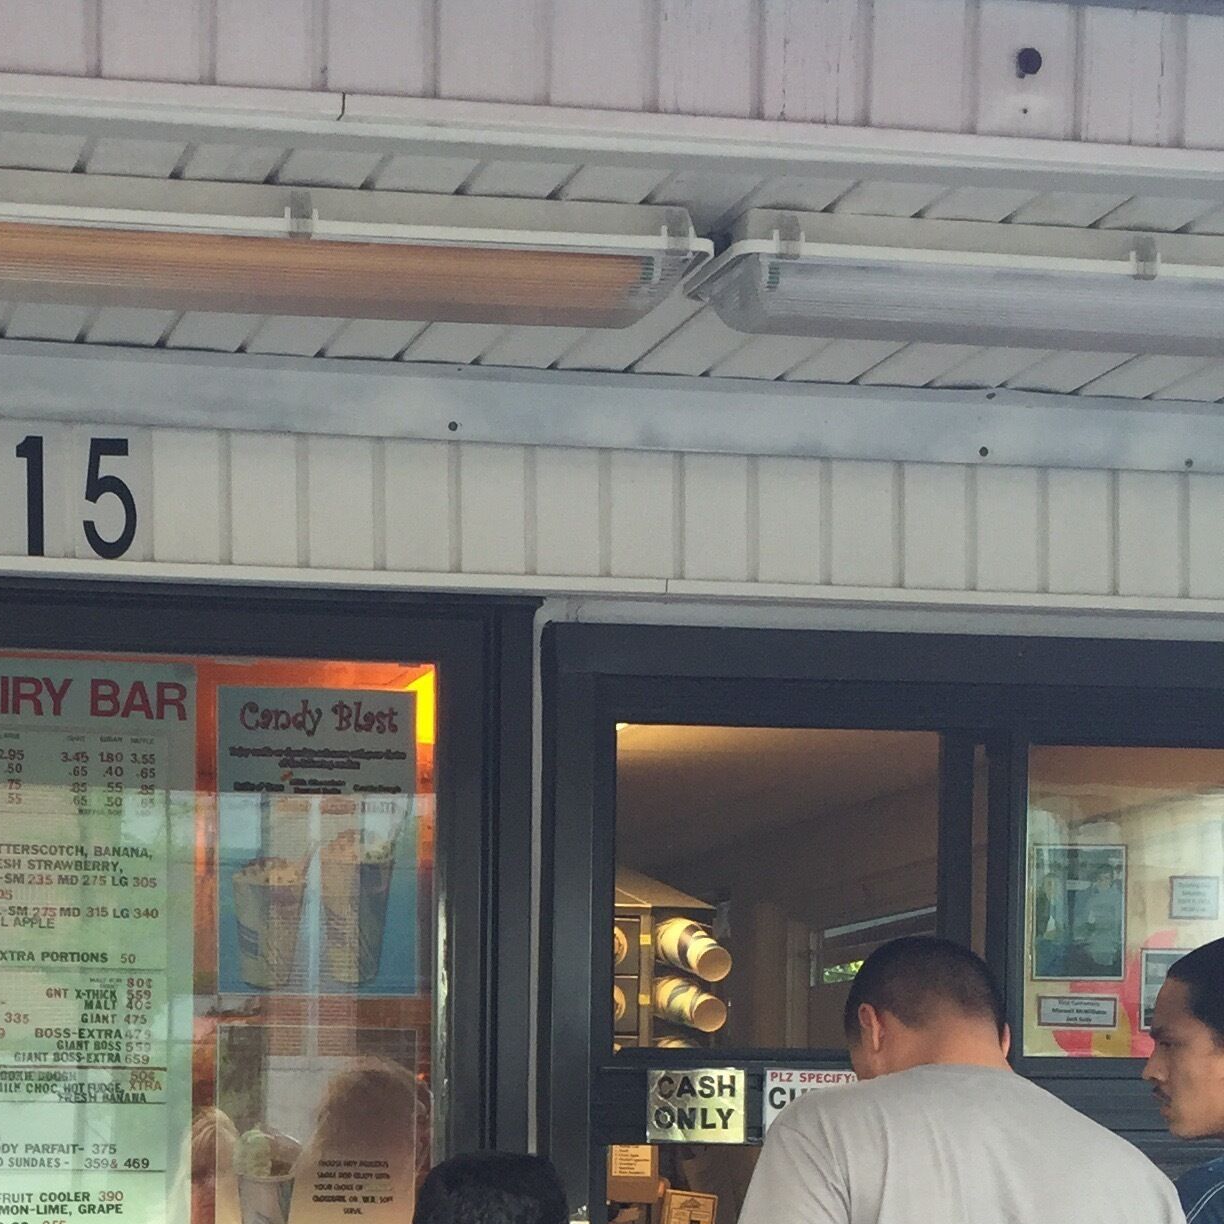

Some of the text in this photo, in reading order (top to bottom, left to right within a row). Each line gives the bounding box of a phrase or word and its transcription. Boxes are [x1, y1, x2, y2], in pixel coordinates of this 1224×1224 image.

[89, 678, 188, 721] BAR
[240, 700, 398, 736] Candy Blast
[658, 1075, 735, 1099] CASH
[770, 1072, 793, 1082] PLZ
[654, 1106, 734, 1129] ONLY
